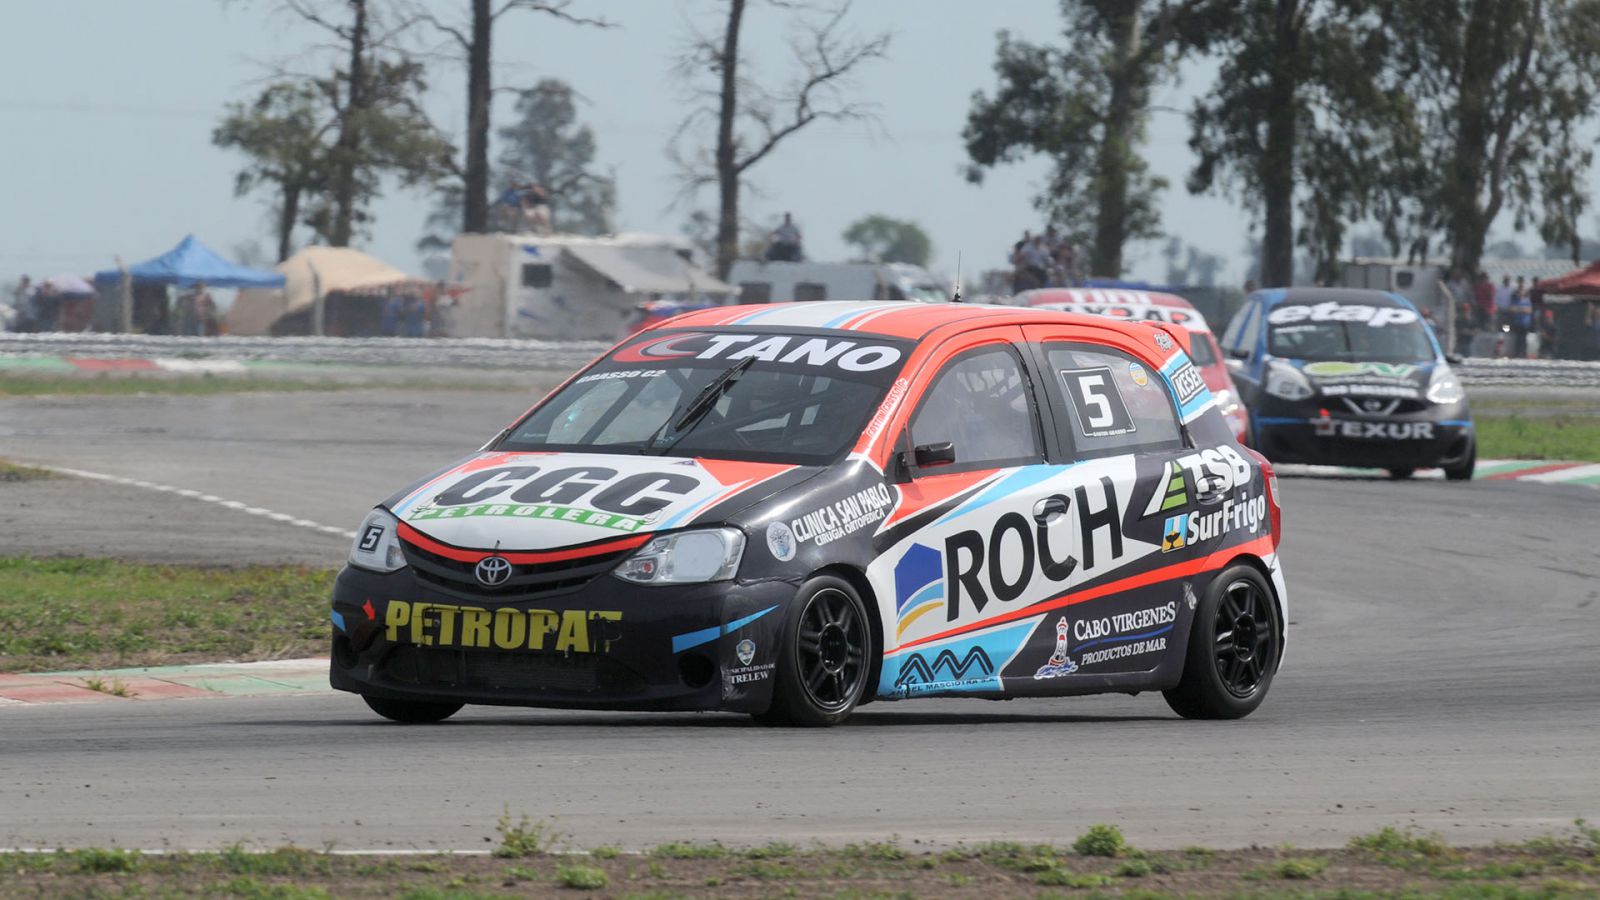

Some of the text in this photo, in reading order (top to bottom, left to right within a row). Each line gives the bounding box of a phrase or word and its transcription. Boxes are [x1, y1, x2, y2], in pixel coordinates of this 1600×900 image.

[1268, 301, 1419, 328] etap
[1078, 374, 1114, 428] 5
[432, 465, 701, 516] CGC
[411, 504, 641, 532] PETROLERA
[792, 482, 892, 543] CLINICA SAN PABLO
[814, 507, 886, 546] CIRUGIA ORTOPEDICA
[1187, 491, 1266, 546] SurFrigo
[361, 527, 382, 549] 5
[944, 475, 1124, 623] ROCH
[1074, 601, 1176, 641] CABO VIRGENES
[1080, 637, 1167, 666] PRODUCTOS DE MAR
[731, 670, 769, 684] TRELEW
